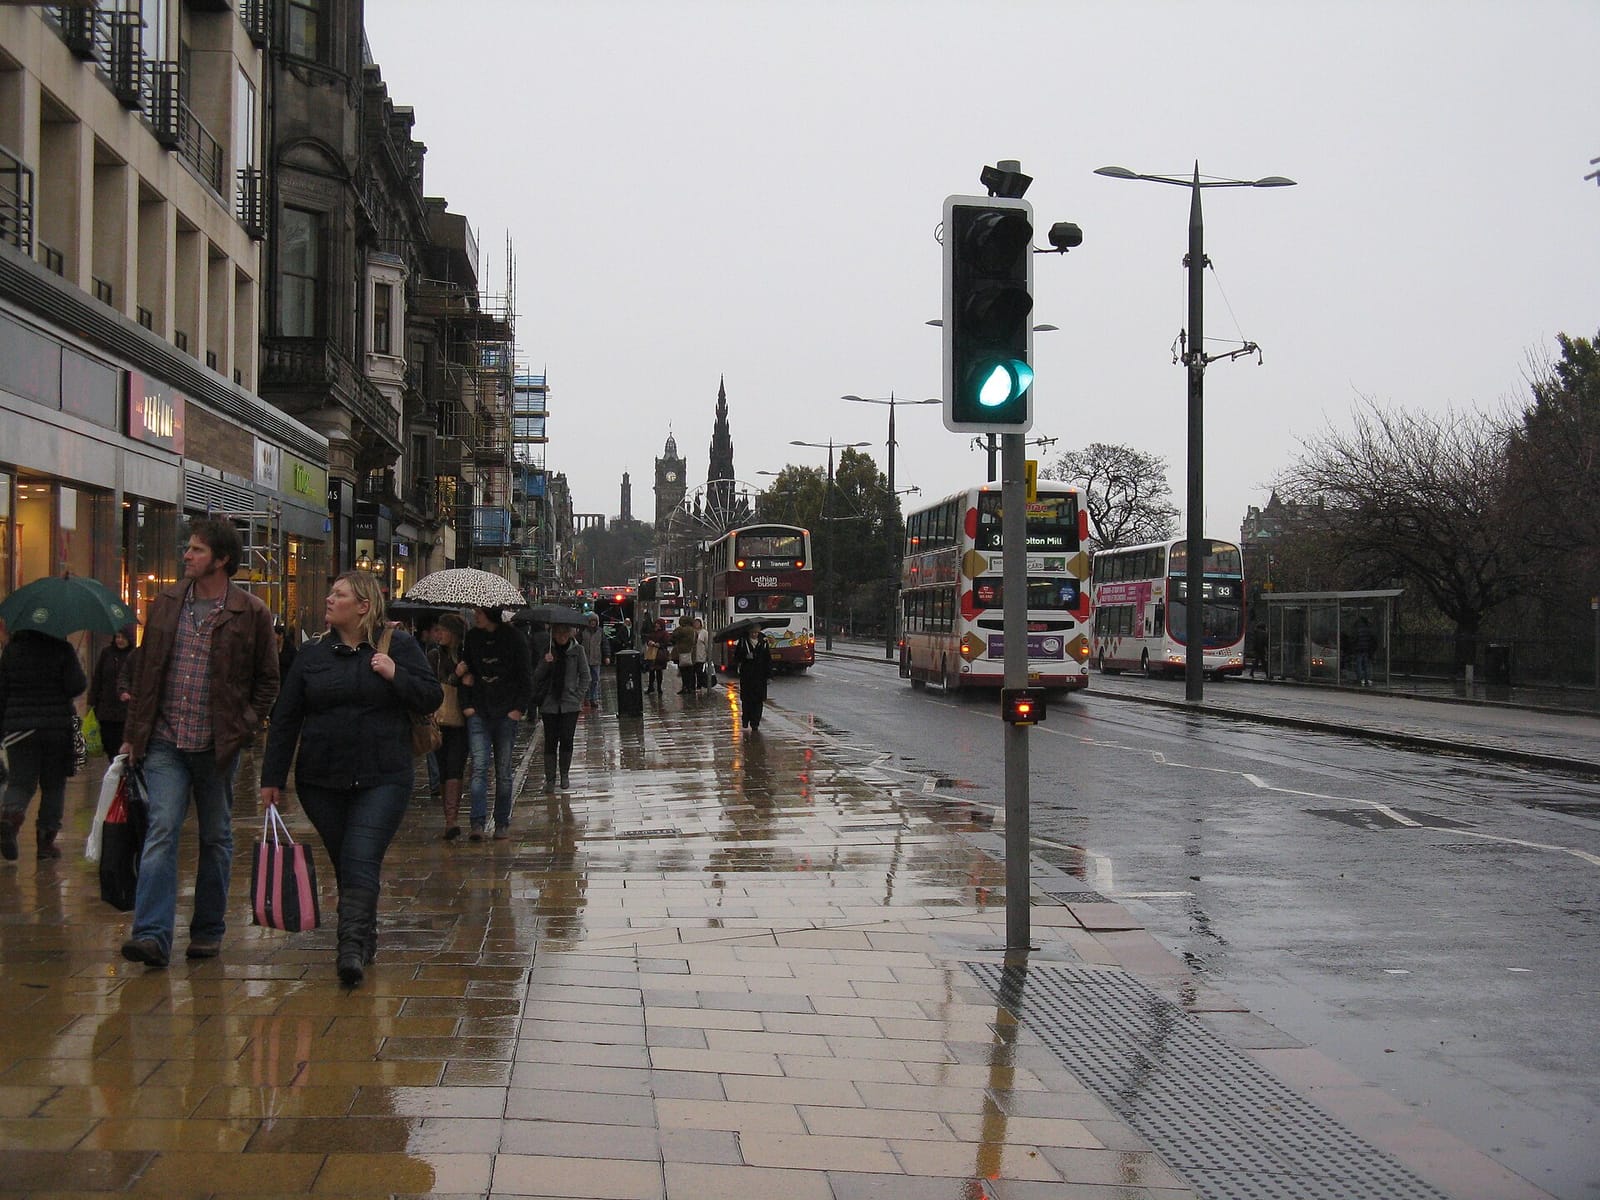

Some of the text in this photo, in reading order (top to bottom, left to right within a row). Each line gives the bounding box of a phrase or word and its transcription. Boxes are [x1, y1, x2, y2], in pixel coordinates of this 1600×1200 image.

[1026, 536, 1046, 546] olton
[1047, 536, 1063, 546] Mill
[750, 575, 778, 585] Lothian
[1218, 586, 1231, 596] 33
